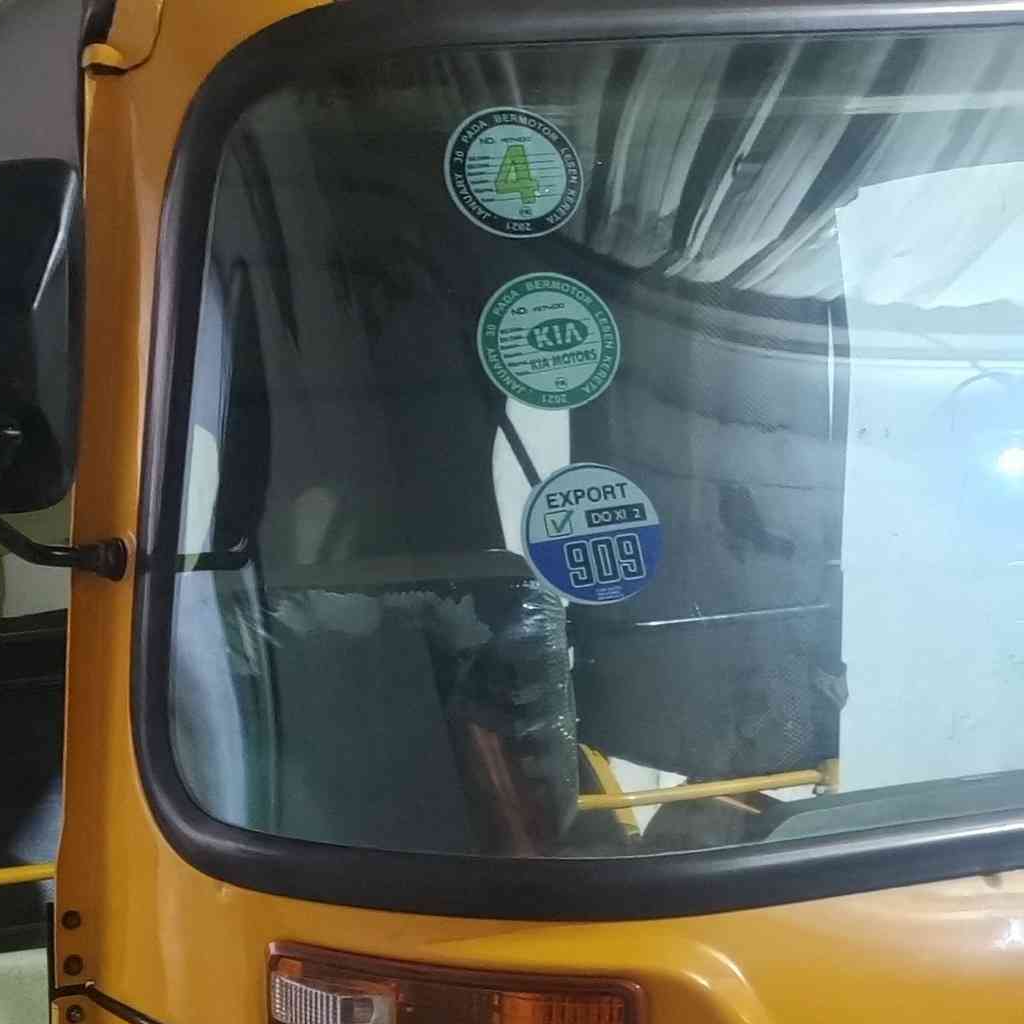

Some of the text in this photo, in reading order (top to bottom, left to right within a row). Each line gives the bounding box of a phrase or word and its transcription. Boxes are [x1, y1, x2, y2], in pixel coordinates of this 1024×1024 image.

[495, 144, 540, 204] 4
[533, 322, 583, 348] KIA
[529, 349, 596, 370] KIA MOTORS
[546, 482, 628, 509] EXPORT
[632, 508, 641, 519] 2
[563, 532, 647, 588] 909
